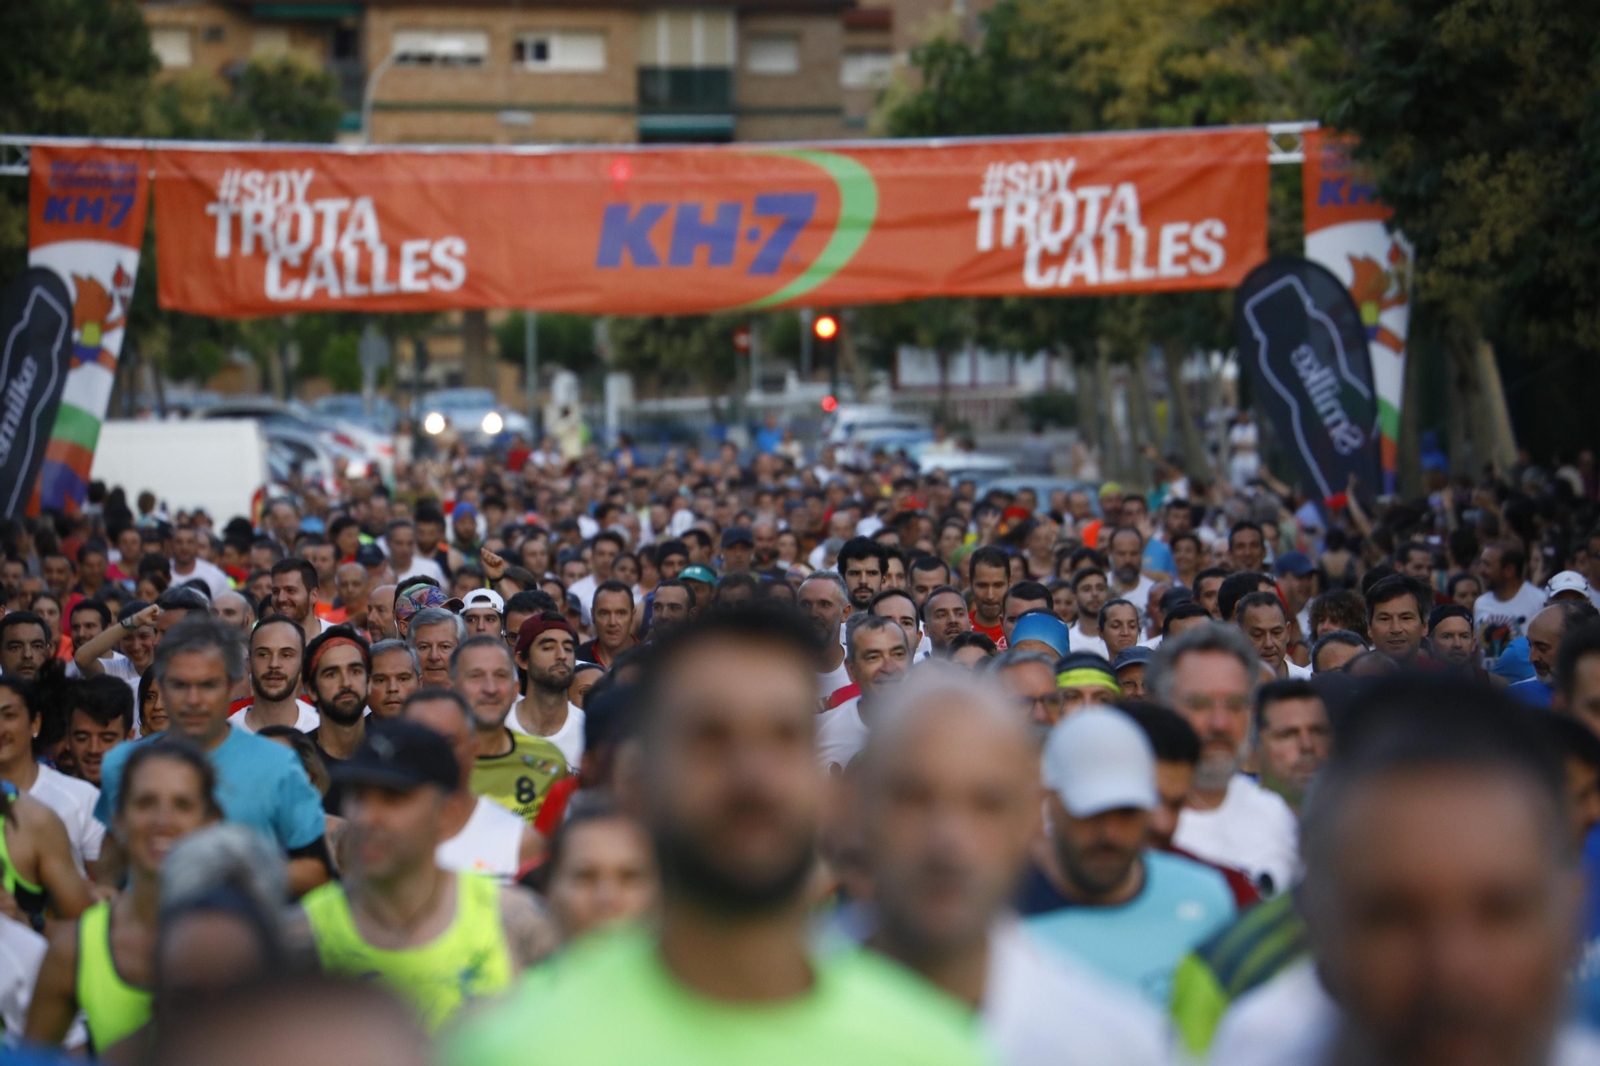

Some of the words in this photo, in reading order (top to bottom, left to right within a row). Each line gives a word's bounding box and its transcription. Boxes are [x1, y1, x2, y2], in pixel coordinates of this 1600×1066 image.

[217, 168, 314, 204] #SOY
[982, 158, 1076, 195] #SOY
[205, 196, 381, 258] TROTA
[969, 182, 1142, 253] TROTA
[265, 237, 467, 301] CALLES
[1023, 219, 1227, 288] CALLES
[515, 775, 536, 804] 8
